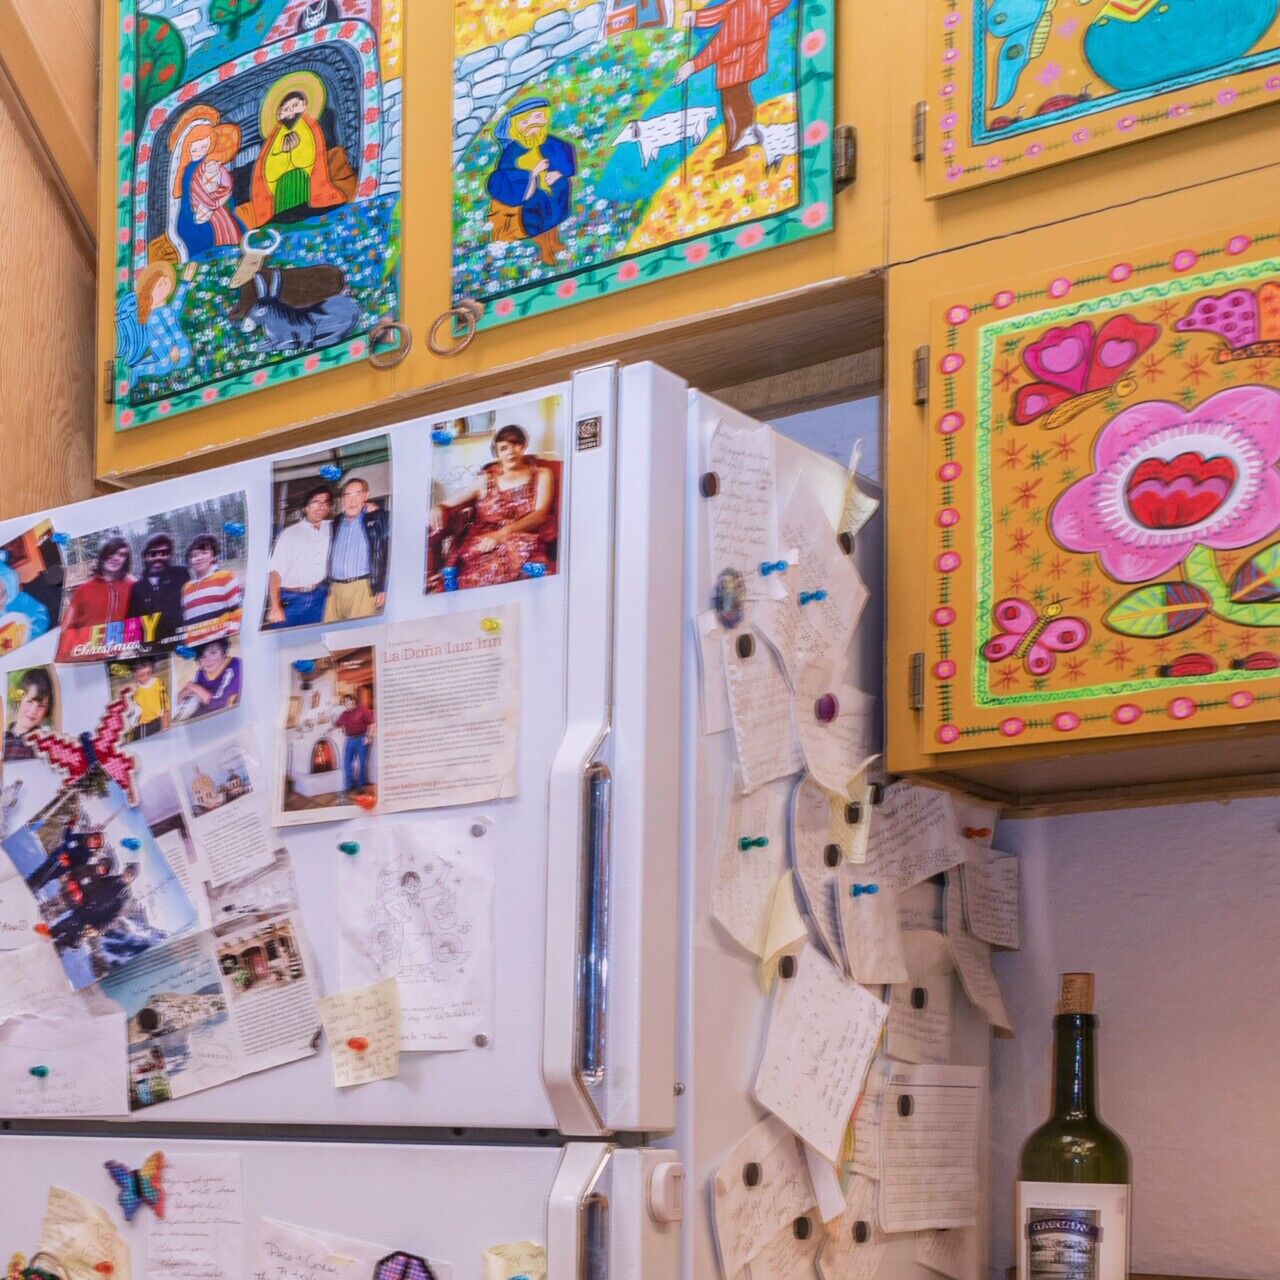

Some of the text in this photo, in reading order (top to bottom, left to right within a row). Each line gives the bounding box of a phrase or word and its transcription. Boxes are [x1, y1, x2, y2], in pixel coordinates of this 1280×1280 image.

[59, 612, 162, 650] MERRY
[72, 639, 152, 657] Christmas
[383, 636, 502, 663] La Doña Luz Inn
